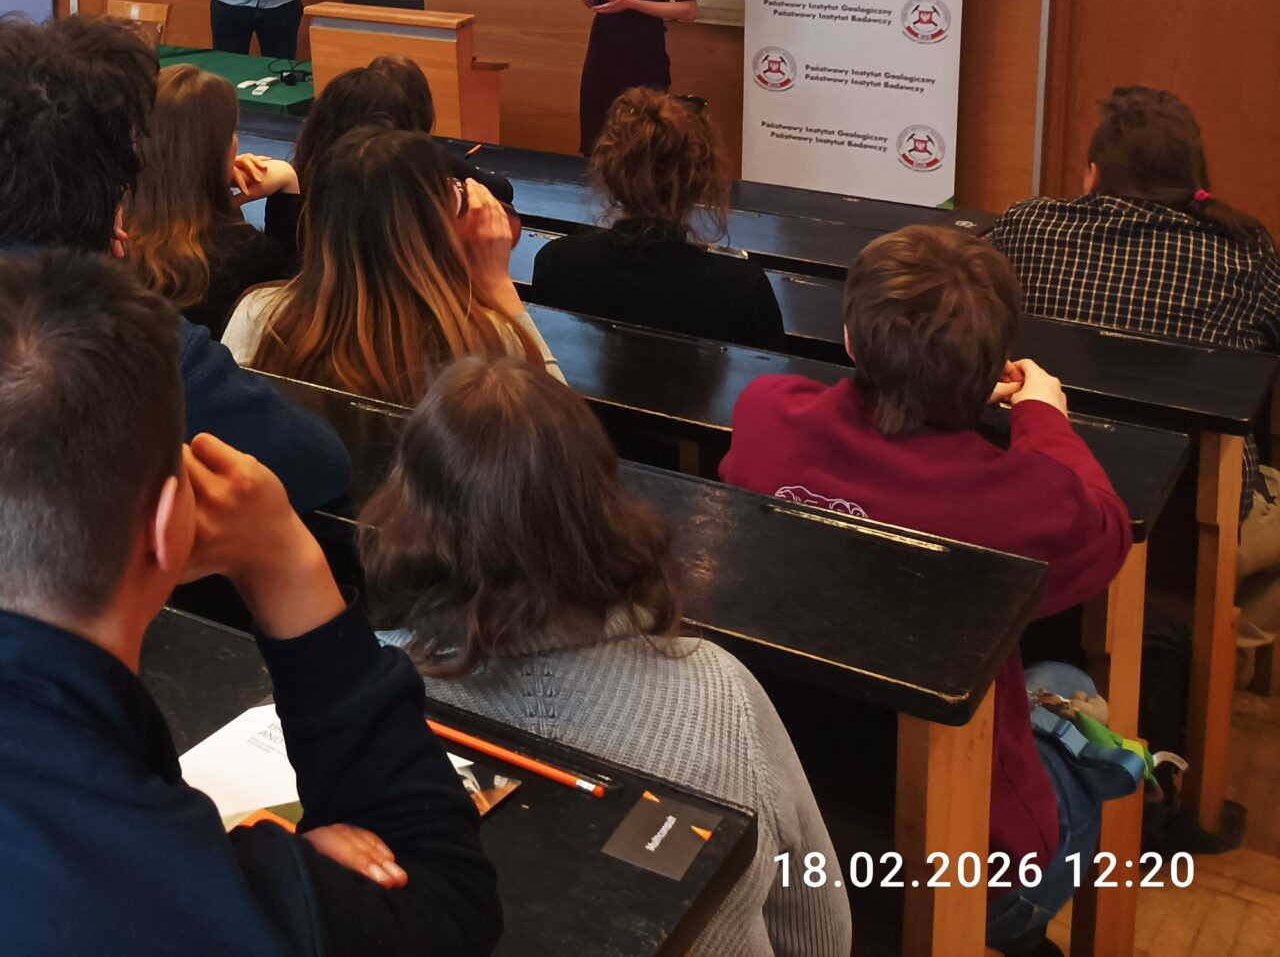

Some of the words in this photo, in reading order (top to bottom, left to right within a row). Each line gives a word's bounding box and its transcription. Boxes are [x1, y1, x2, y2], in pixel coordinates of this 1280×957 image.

[763, 0, 806, 10] Państwowy
[809, 3, 838, 11] Instytut
[841, 5, 892, 16] Geologiczny
[773, 9, 816, 19] Państwowy
[819, 13, 849, 22] Instytut
[851, 16, 892, 26] Badawczy
[805, 64, 849, 76] Państwowy
[851, 69, 881, 78] Instytut
[884, 72, 936, 85] Geologiczny
[805, 74, 848, 85] Państwowy
[851, 78, 881, 87] Instytut
[884, 82, 925, 93] Badawczy
[761, 121, 803, 133] Państwowy
[806, 126, 834, 135] Instytut
[837, 130, 888, 143] Geologiczny
[770, 131, 813, 143] Państwowy
[816, 137, 845, 146] Instytut
[847, 141, 887, 153] Badawczy
